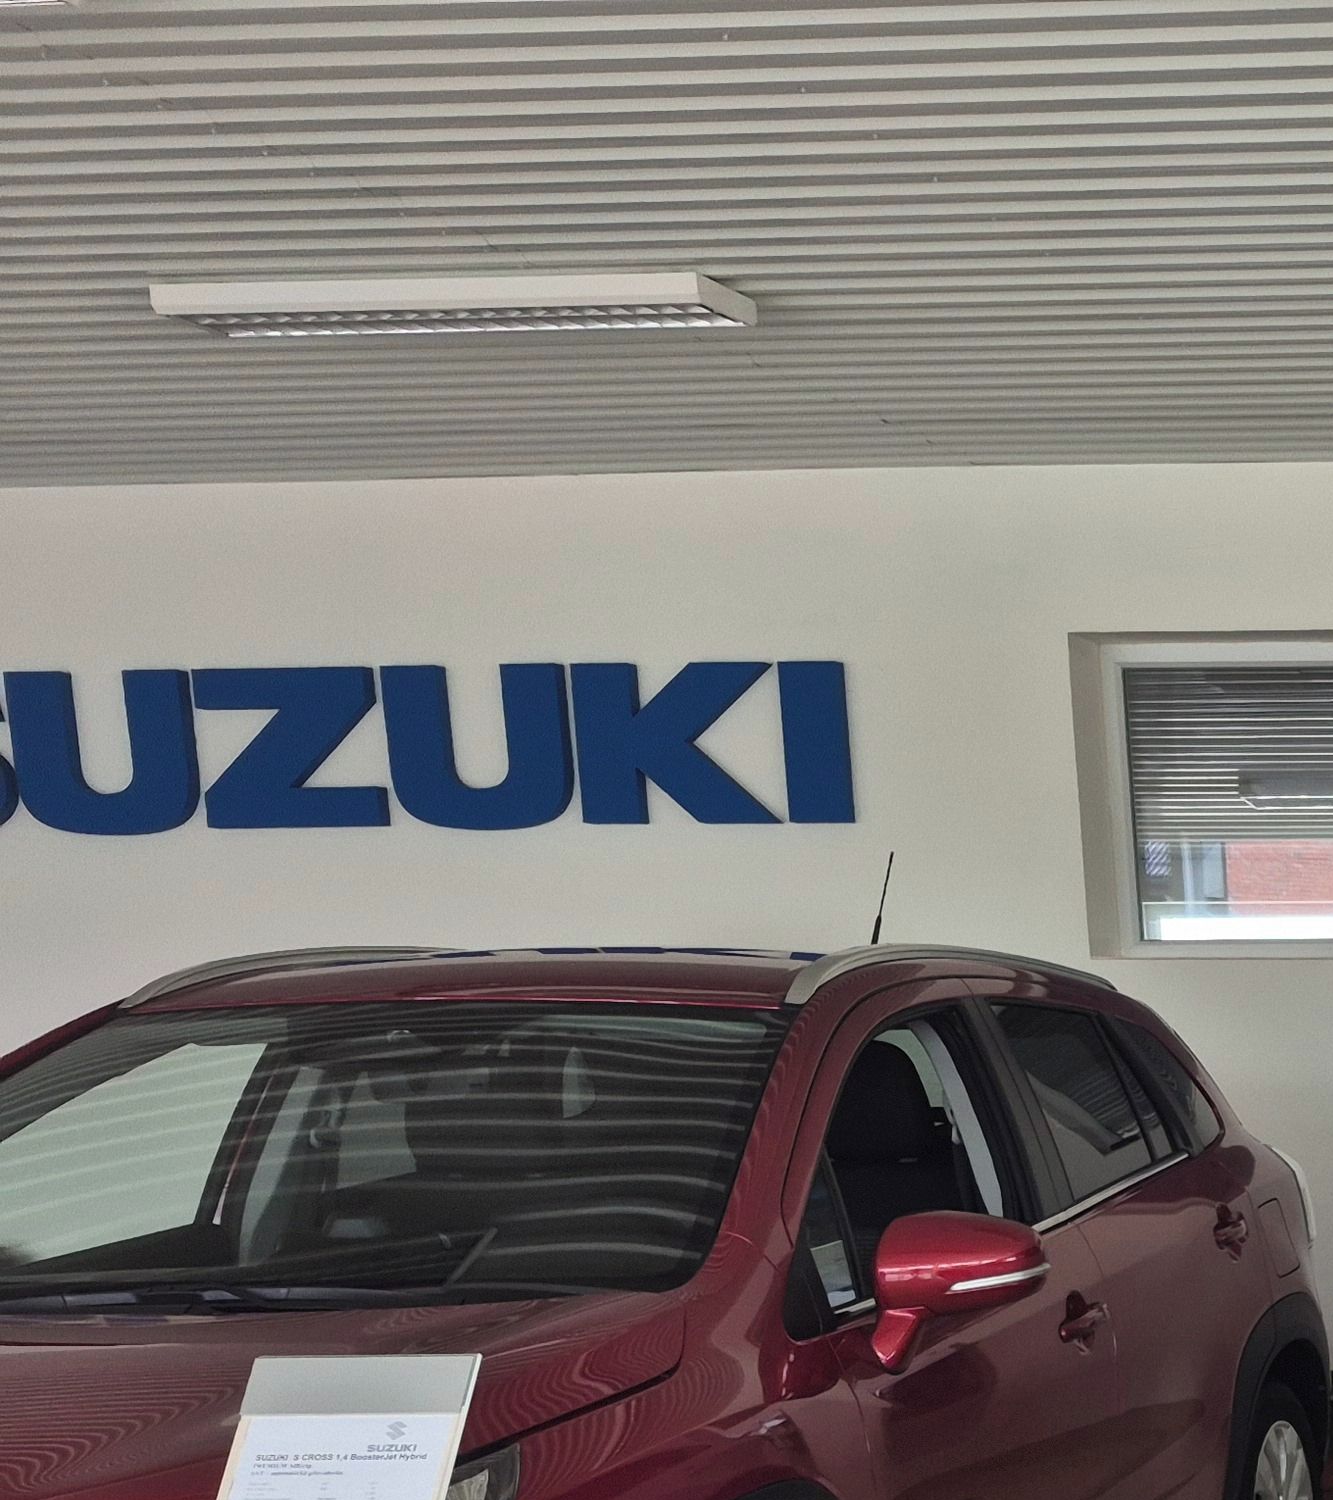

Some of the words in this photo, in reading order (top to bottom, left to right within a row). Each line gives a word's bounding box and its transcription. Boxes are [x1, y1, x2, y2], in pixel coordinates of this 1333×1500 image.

[0, 660, 857, 836] UZUKI
[367, 1443, 418, 1453] SUZUKI
[302, 1453, 333, 1461] CROSS
[399, 1452, 428, 1461] Hybrid
